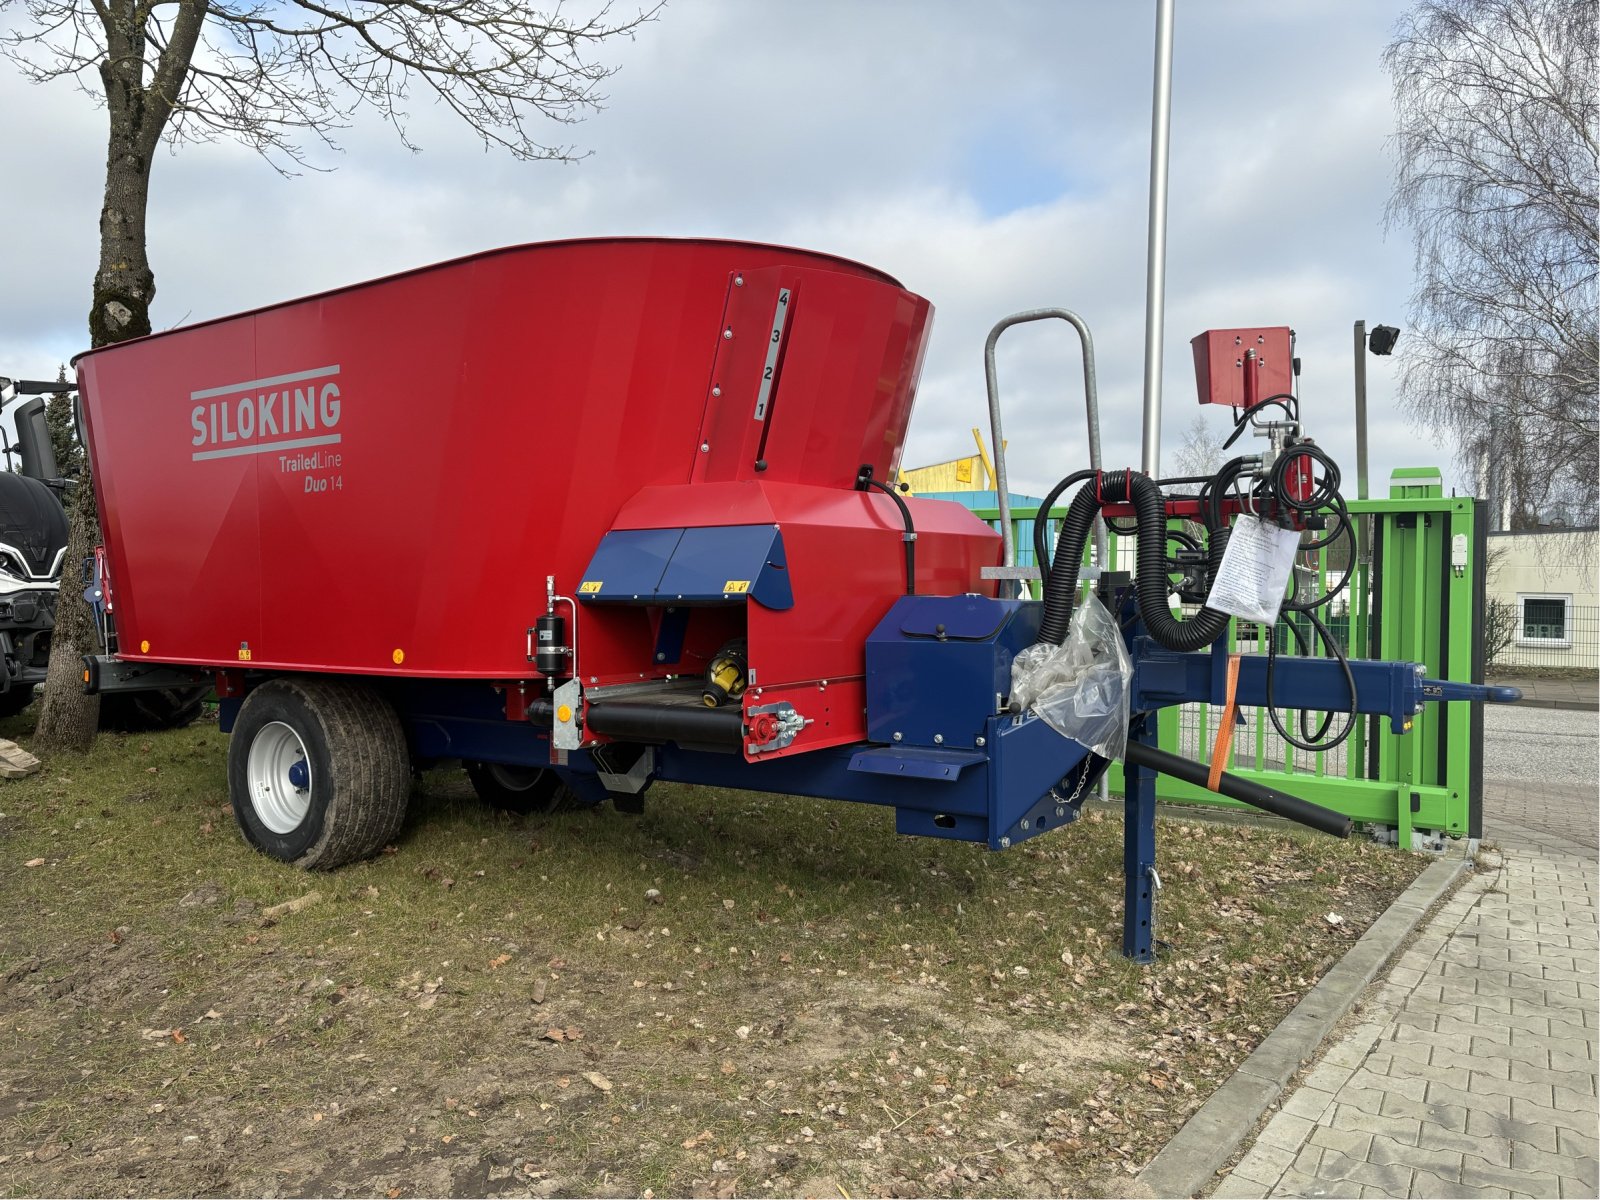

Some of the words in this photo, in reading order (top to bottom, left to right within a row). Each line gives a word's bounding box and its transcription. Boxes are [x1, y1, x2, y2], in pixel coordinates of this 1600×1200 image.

[779, 292, 788, 306] 4
[772, 330, 780, 343] 3
[764, 366, 773, 380] 2
[191, 383, 341, 446] SILOKING
[758, 403, 765, 416] 1
[279, 450, 342, 473] TrailedLine
[304, 475, 327, 493] Duo
[330, 475, 343, 491] 14
